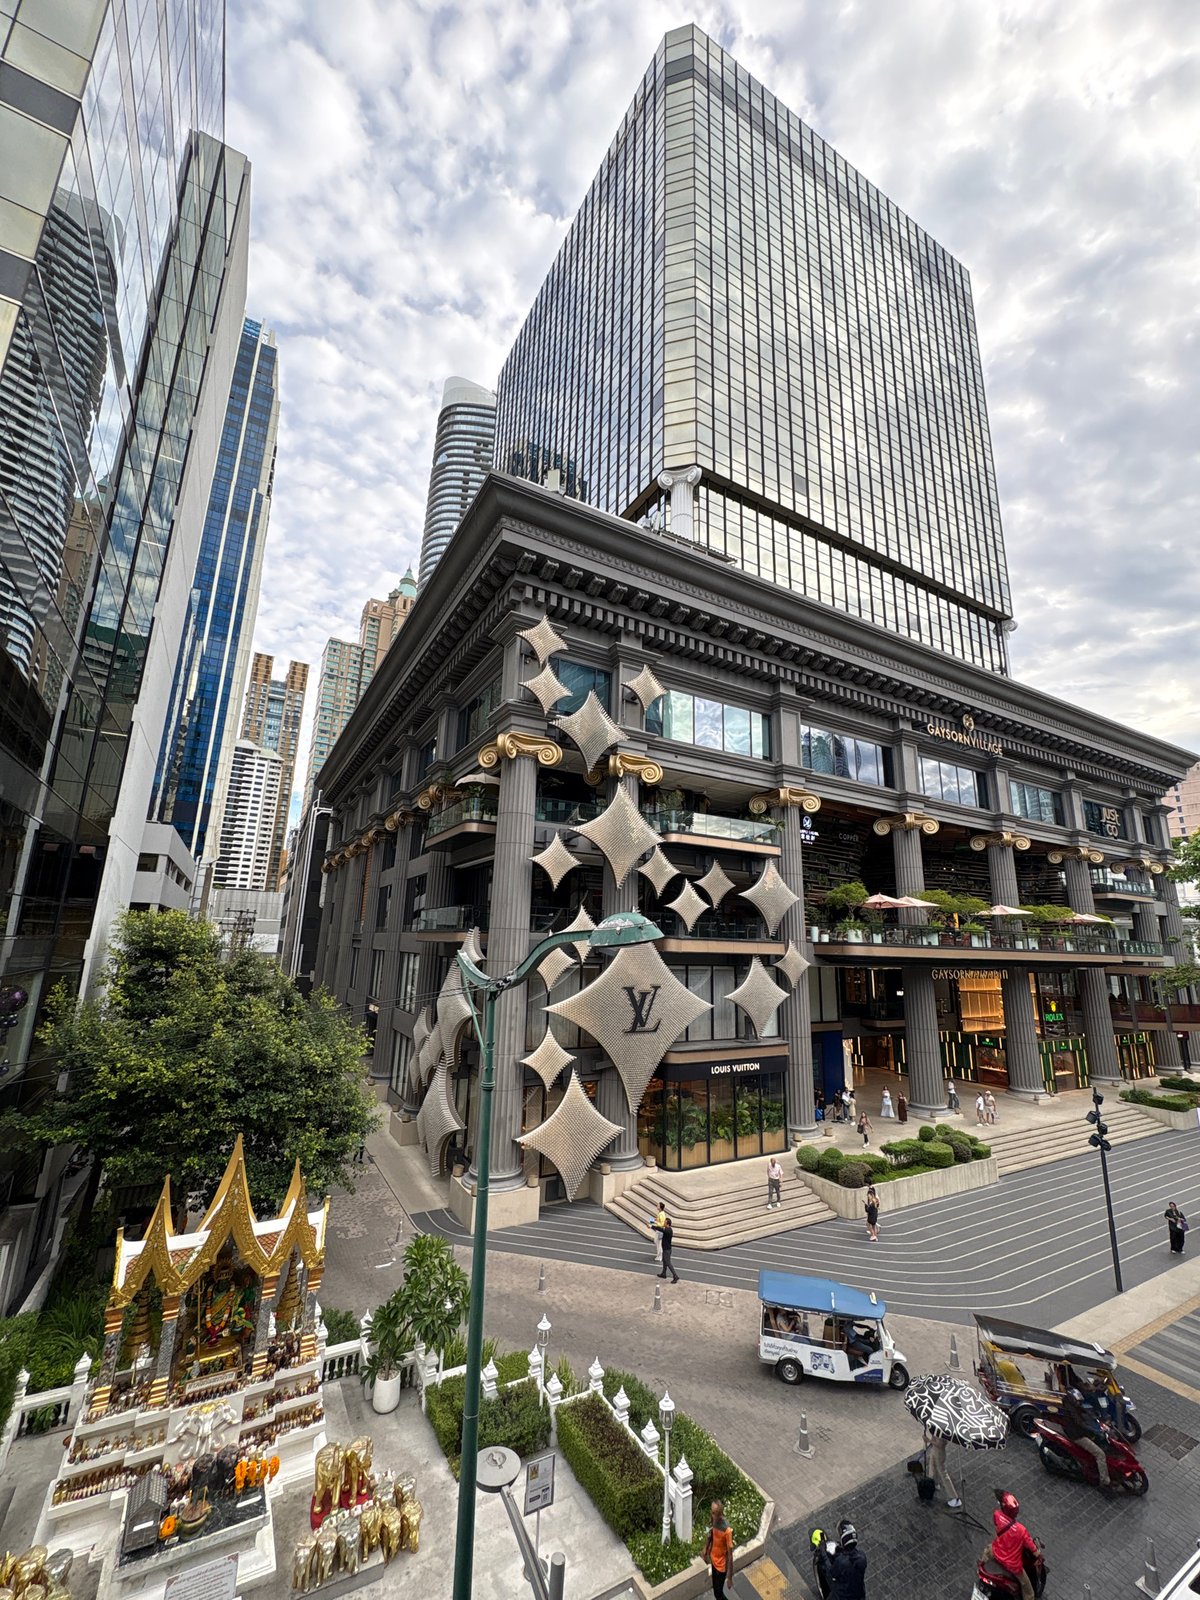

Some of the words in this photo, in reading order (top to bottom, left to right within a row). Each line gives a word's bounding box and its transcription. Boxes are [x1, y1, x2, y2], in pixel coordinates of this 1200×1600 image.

[1045, 1013, 1064, 1021] ROLEX
[711, 1065, 731, 1074] LOUIS
[732, 1063, 760, 1072] VUITTON
